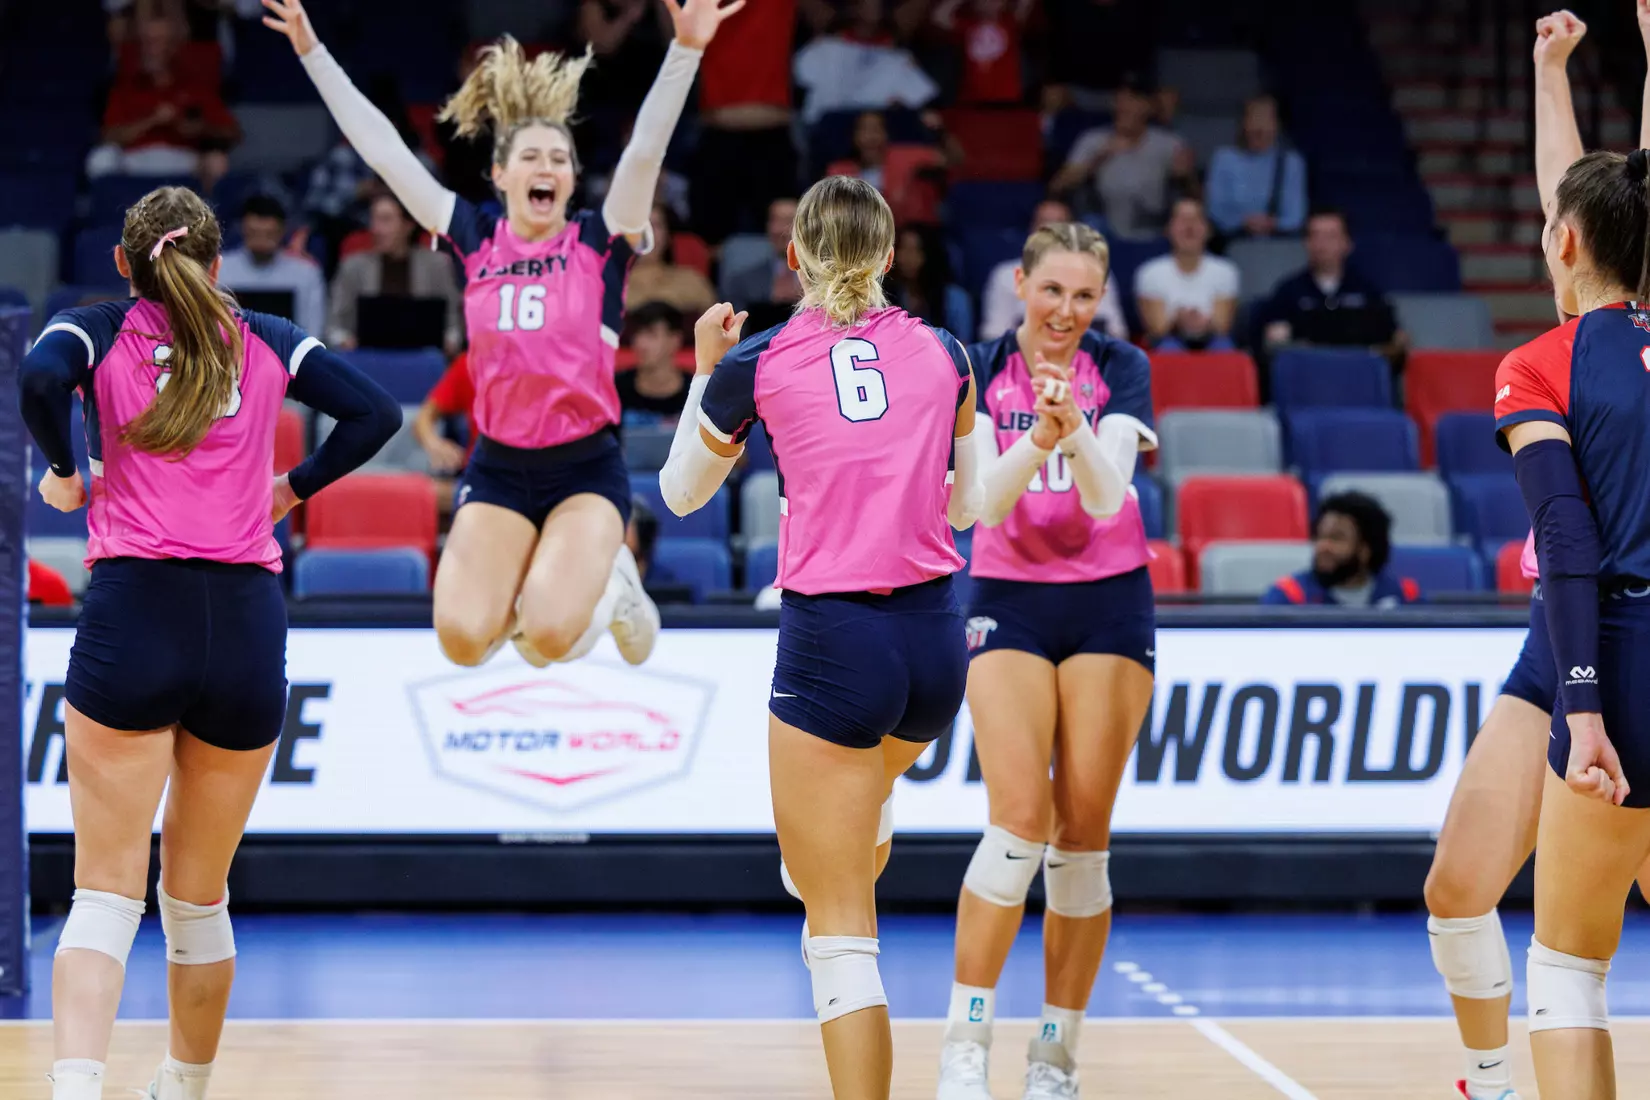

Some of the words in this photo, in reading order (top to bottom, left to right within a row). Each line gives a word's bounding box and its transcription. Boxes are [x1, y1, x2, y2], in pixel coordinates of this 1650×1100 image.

[478, 255, 567, 279] ERTY
[497, 282, 547, 332] 16
[829, 337, 889, 423] 6
[997, 408, 1098, 431] LIBY
[442, 729, 560, 751] MOTOR
